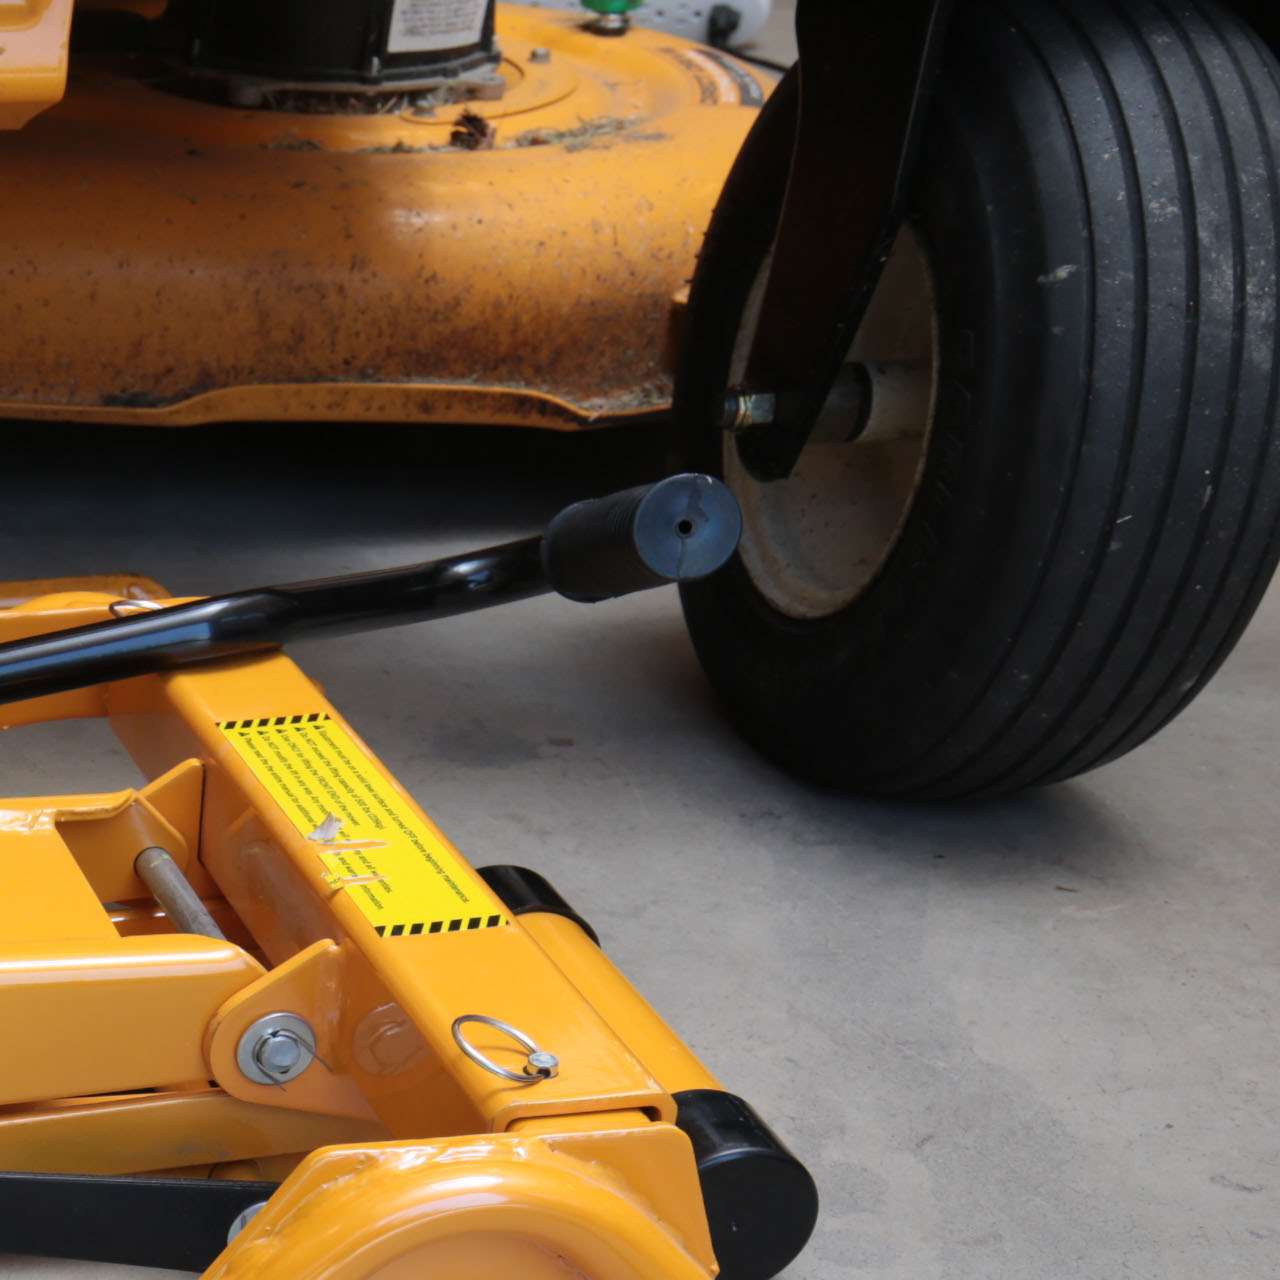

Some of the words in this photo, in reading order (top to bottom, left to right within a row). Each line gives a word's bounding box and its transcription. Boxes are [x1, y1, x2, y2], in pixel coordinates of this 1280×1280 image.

[404, 829, 416, 838] OFF
[412, 839, 428, 852] before
[422, 852, 446, 874] beginning
